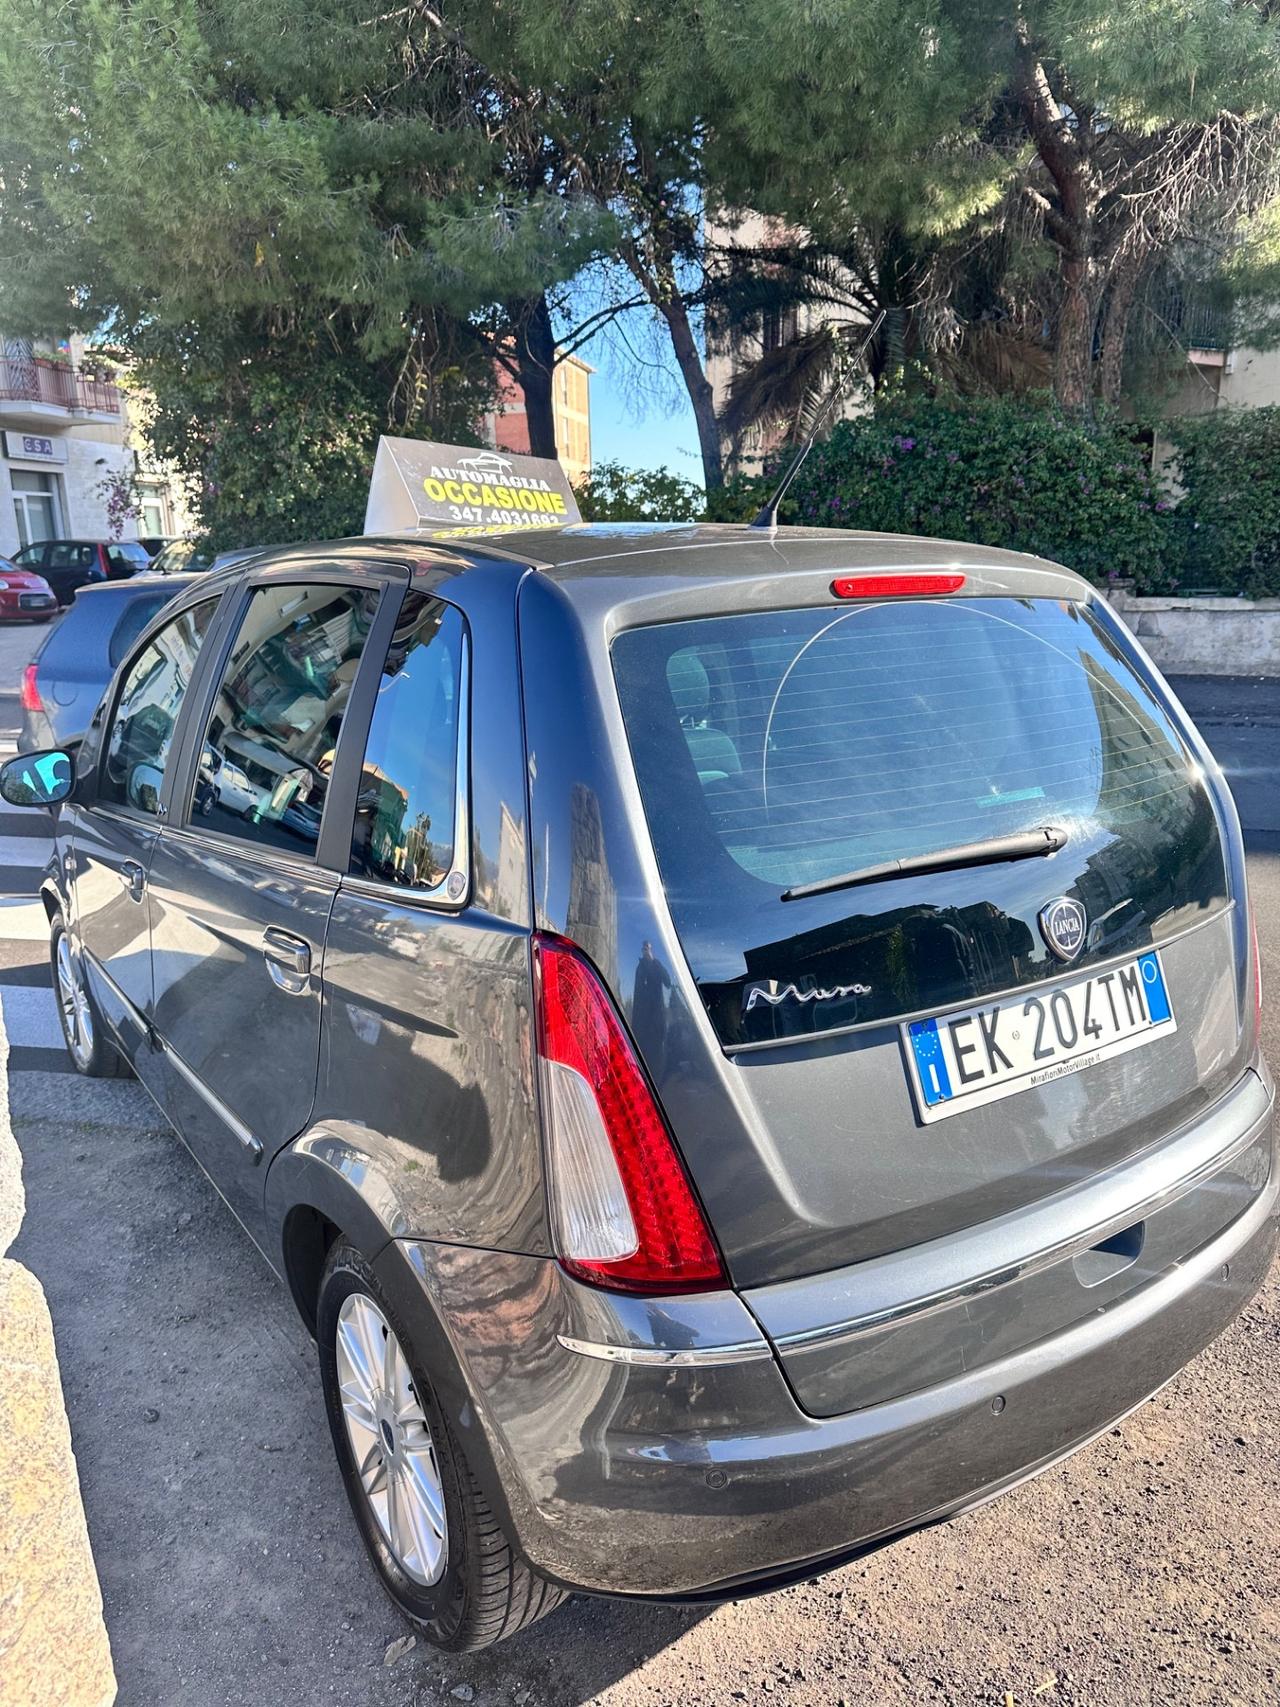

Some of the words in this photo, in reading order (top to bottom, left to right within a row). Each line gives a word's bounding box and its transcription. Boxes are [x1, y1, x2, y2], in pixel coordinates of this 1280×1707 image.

[430, 465, 551, 492] AUTOMAGLIA
[423, 477, 568, 515] OCCASIONE
[1054, 917, 1080, 936] LANCIA
[948, 1006, 1014, 1085] EK
[1023, 965, 1148, 1061] 204TM
